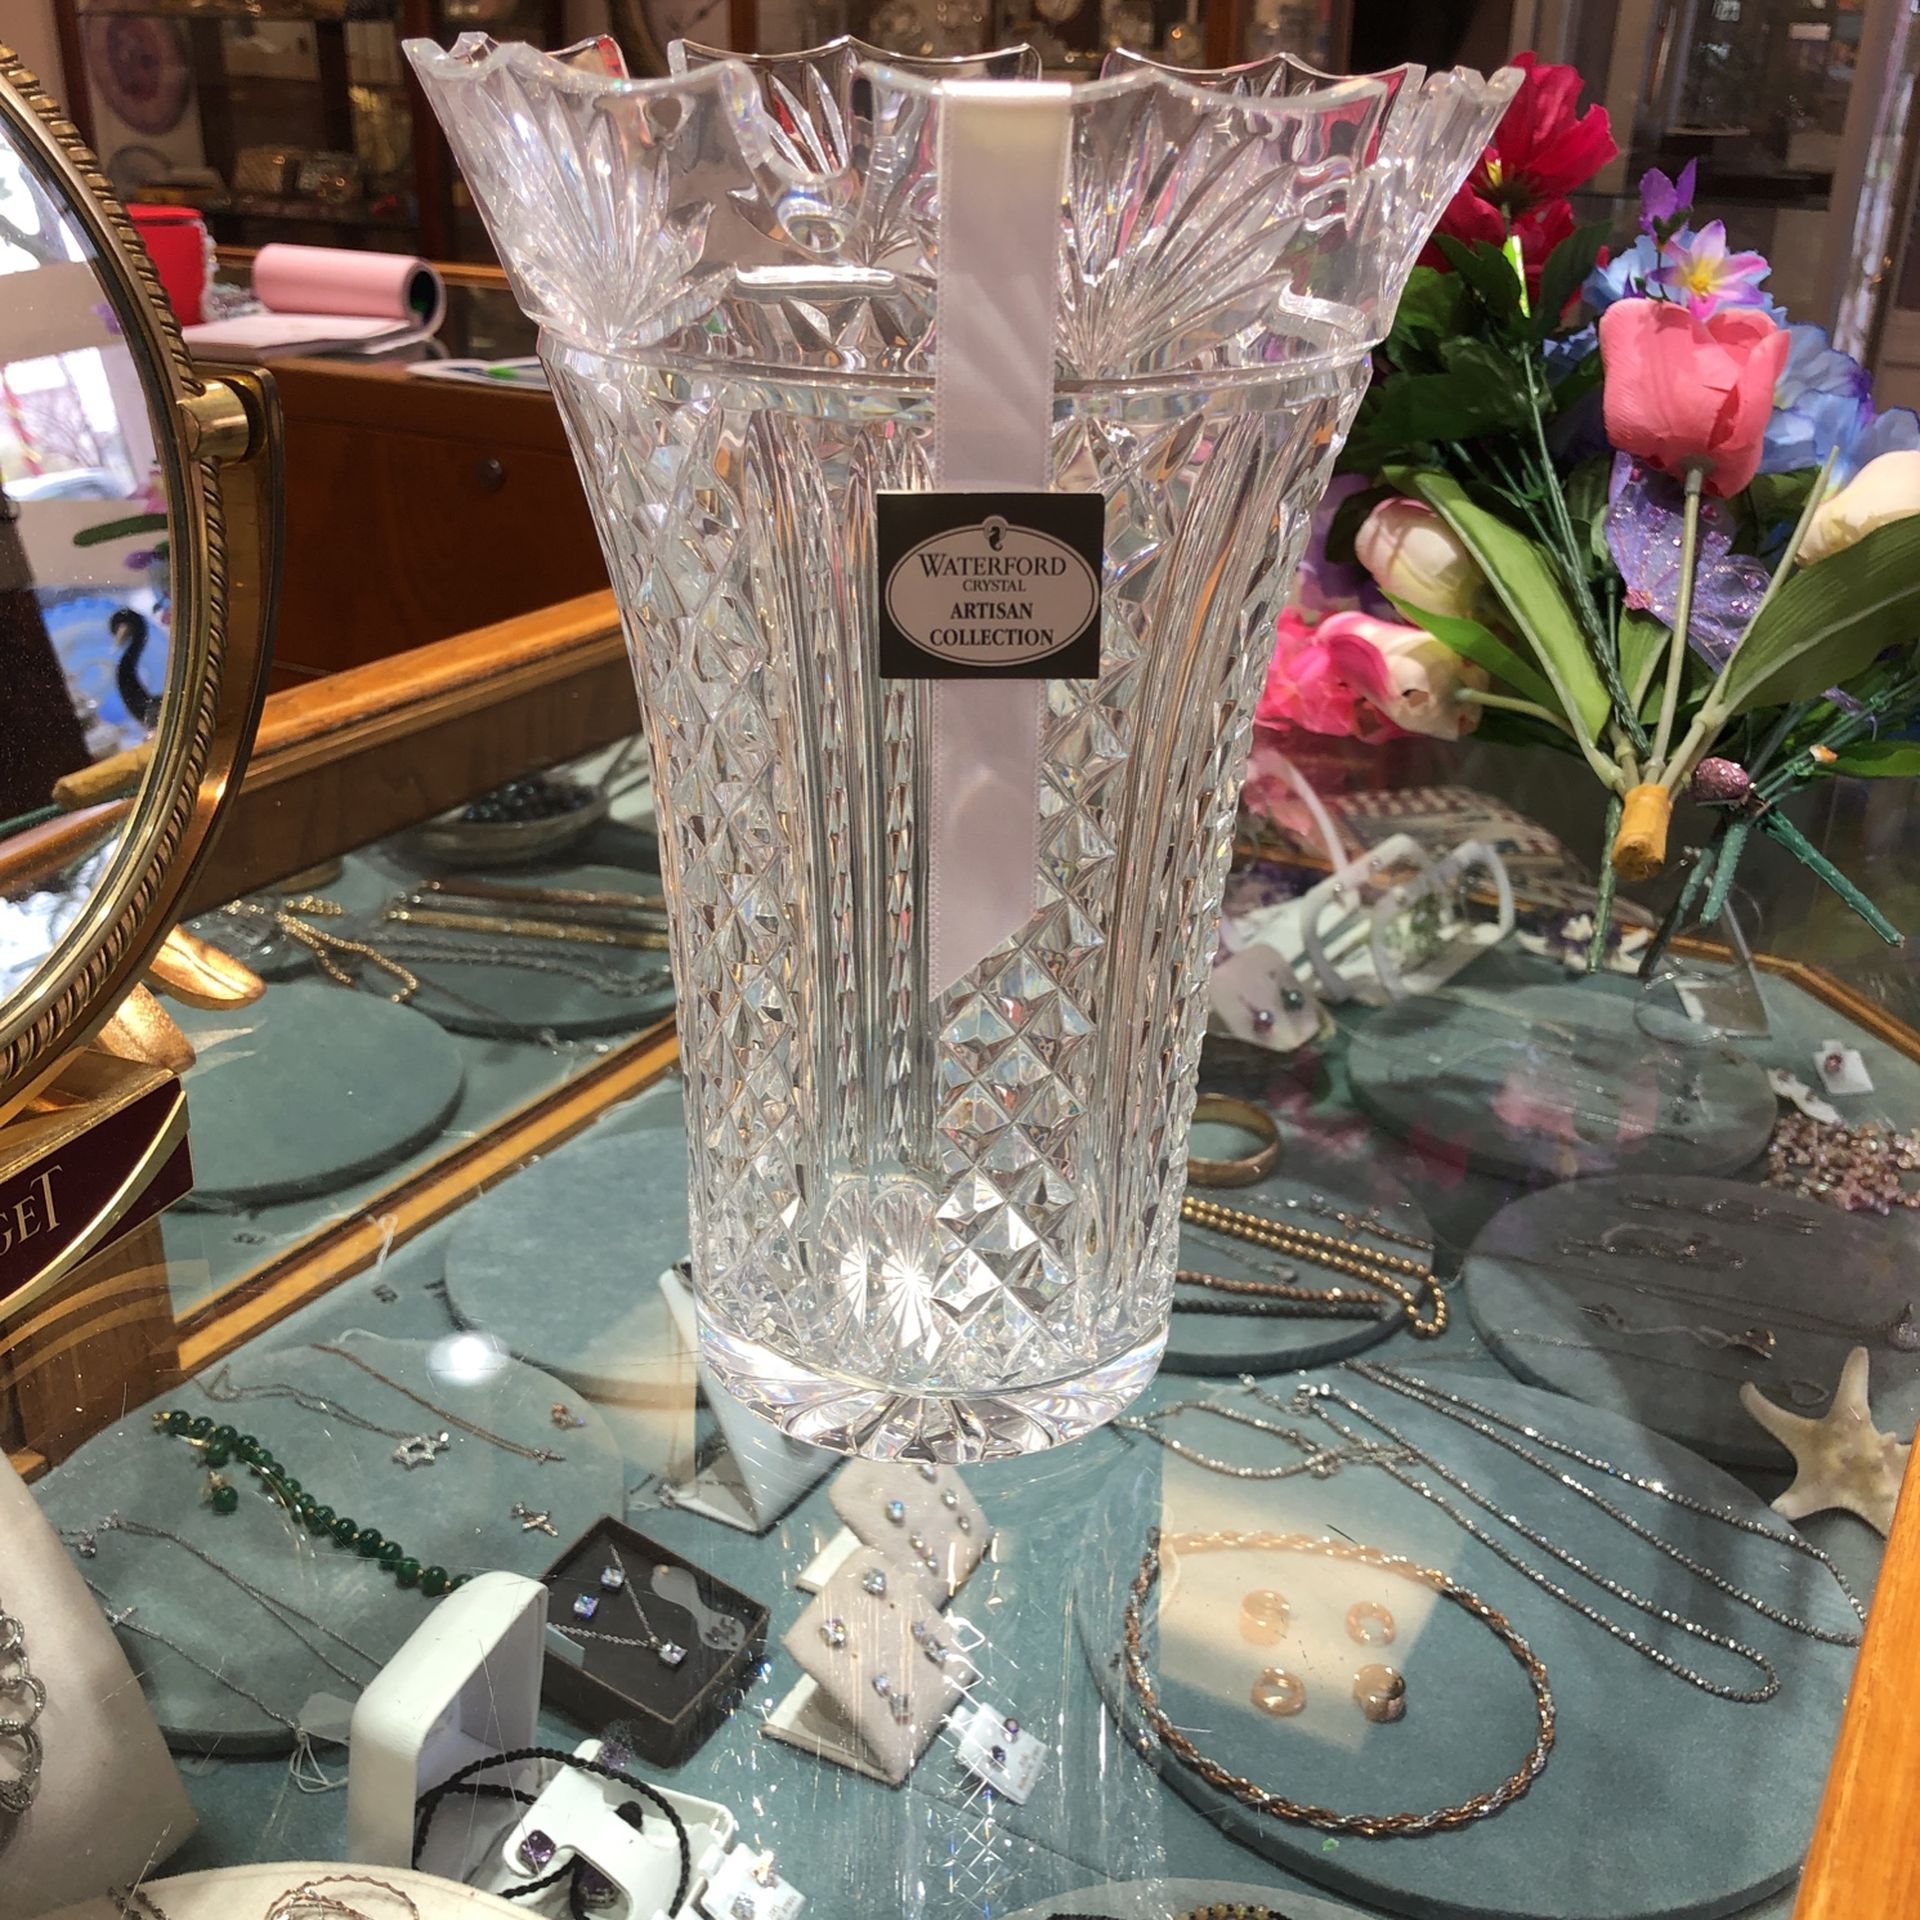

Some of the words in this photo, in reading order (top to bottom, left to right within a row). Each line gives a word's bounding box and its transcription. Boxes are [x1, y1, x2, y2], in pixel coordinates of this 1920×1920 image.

[918, 553, 1066, 577] WATERFORD
[962, 579, 1027, 592] CRYSTAL
[950, 602, 1034, 620] ARTISAN
[929, 628, 1054, 646] COLLECTION
